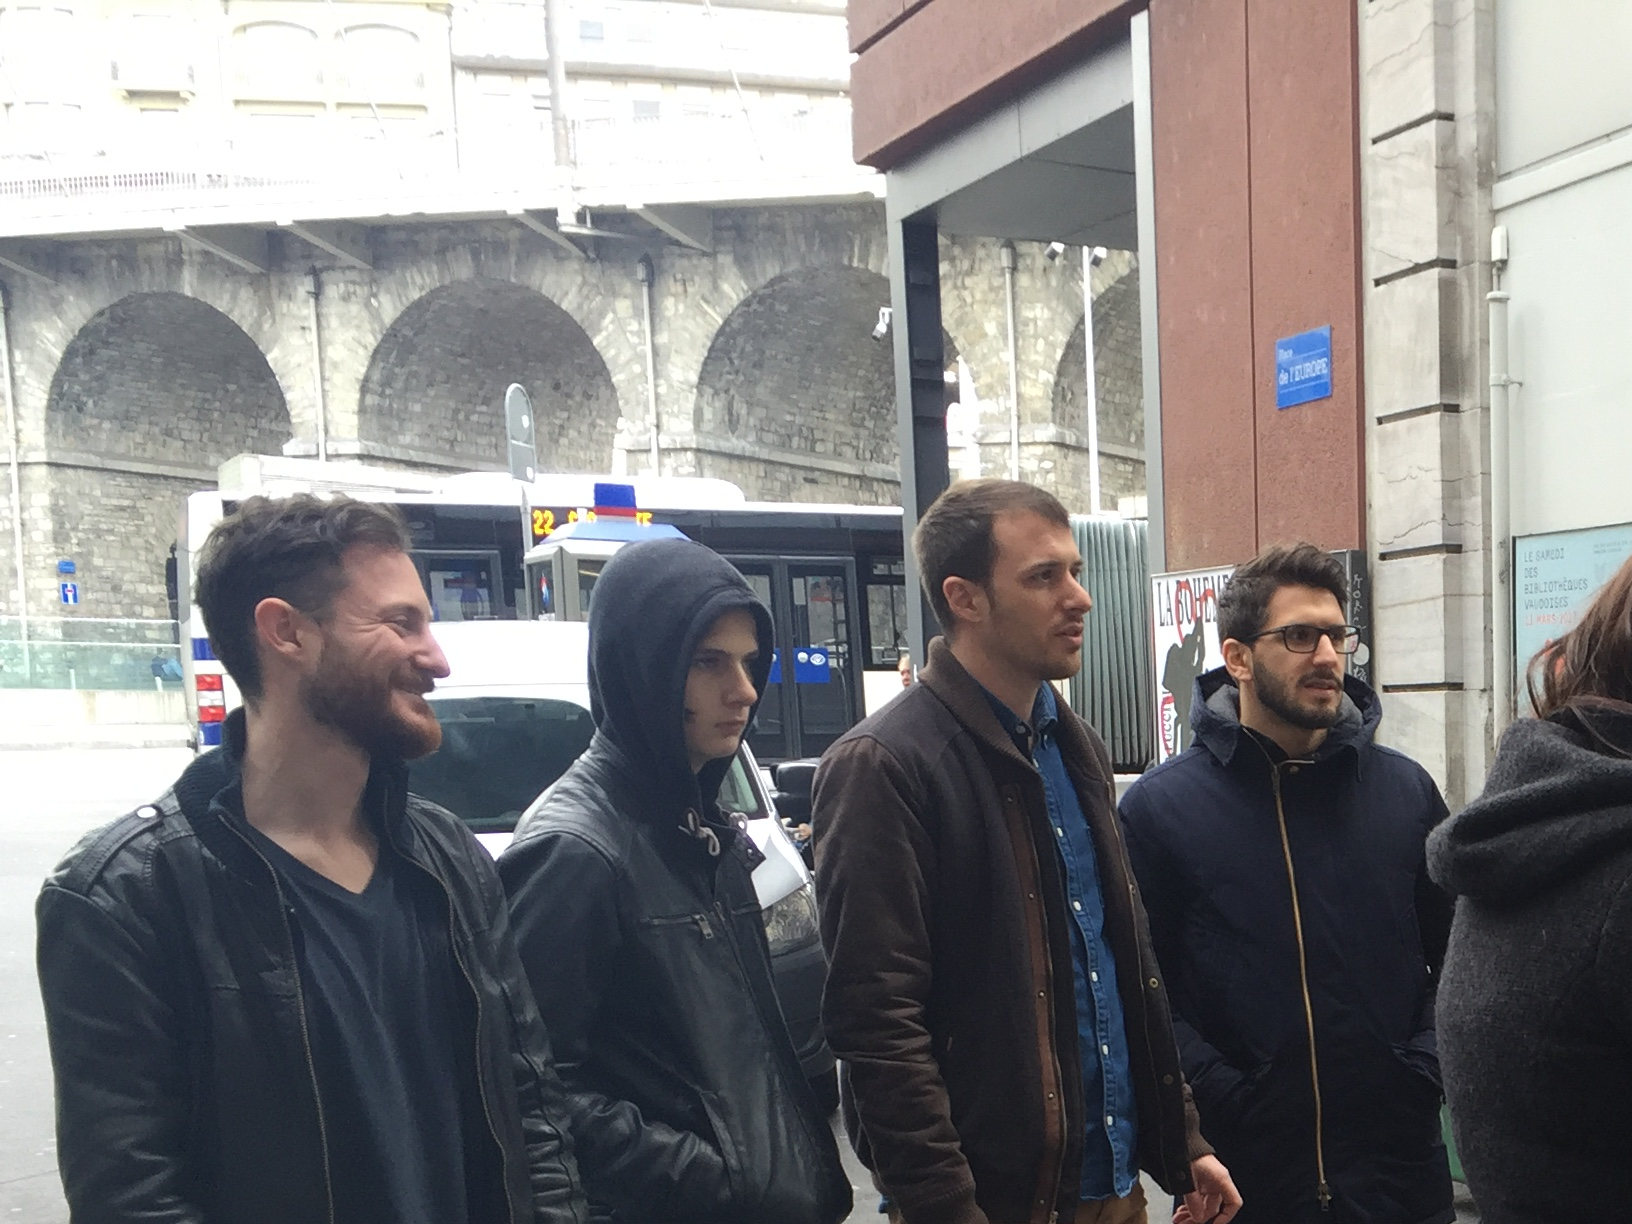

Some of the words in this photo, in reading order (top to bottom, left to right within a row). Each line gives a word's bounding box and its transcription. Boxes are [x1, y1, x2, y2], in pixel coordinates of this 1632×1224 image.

[533, 509, 555, 535] 22
[1524, 552, 1533, 563] LE
[1536, 548, 1565, 562] SAMEDI
[1524, 567, 1538, 579] DES
[1157, 581, 1174, 627] LA
[1524, 596, 1569, 610] VAUDOISES
